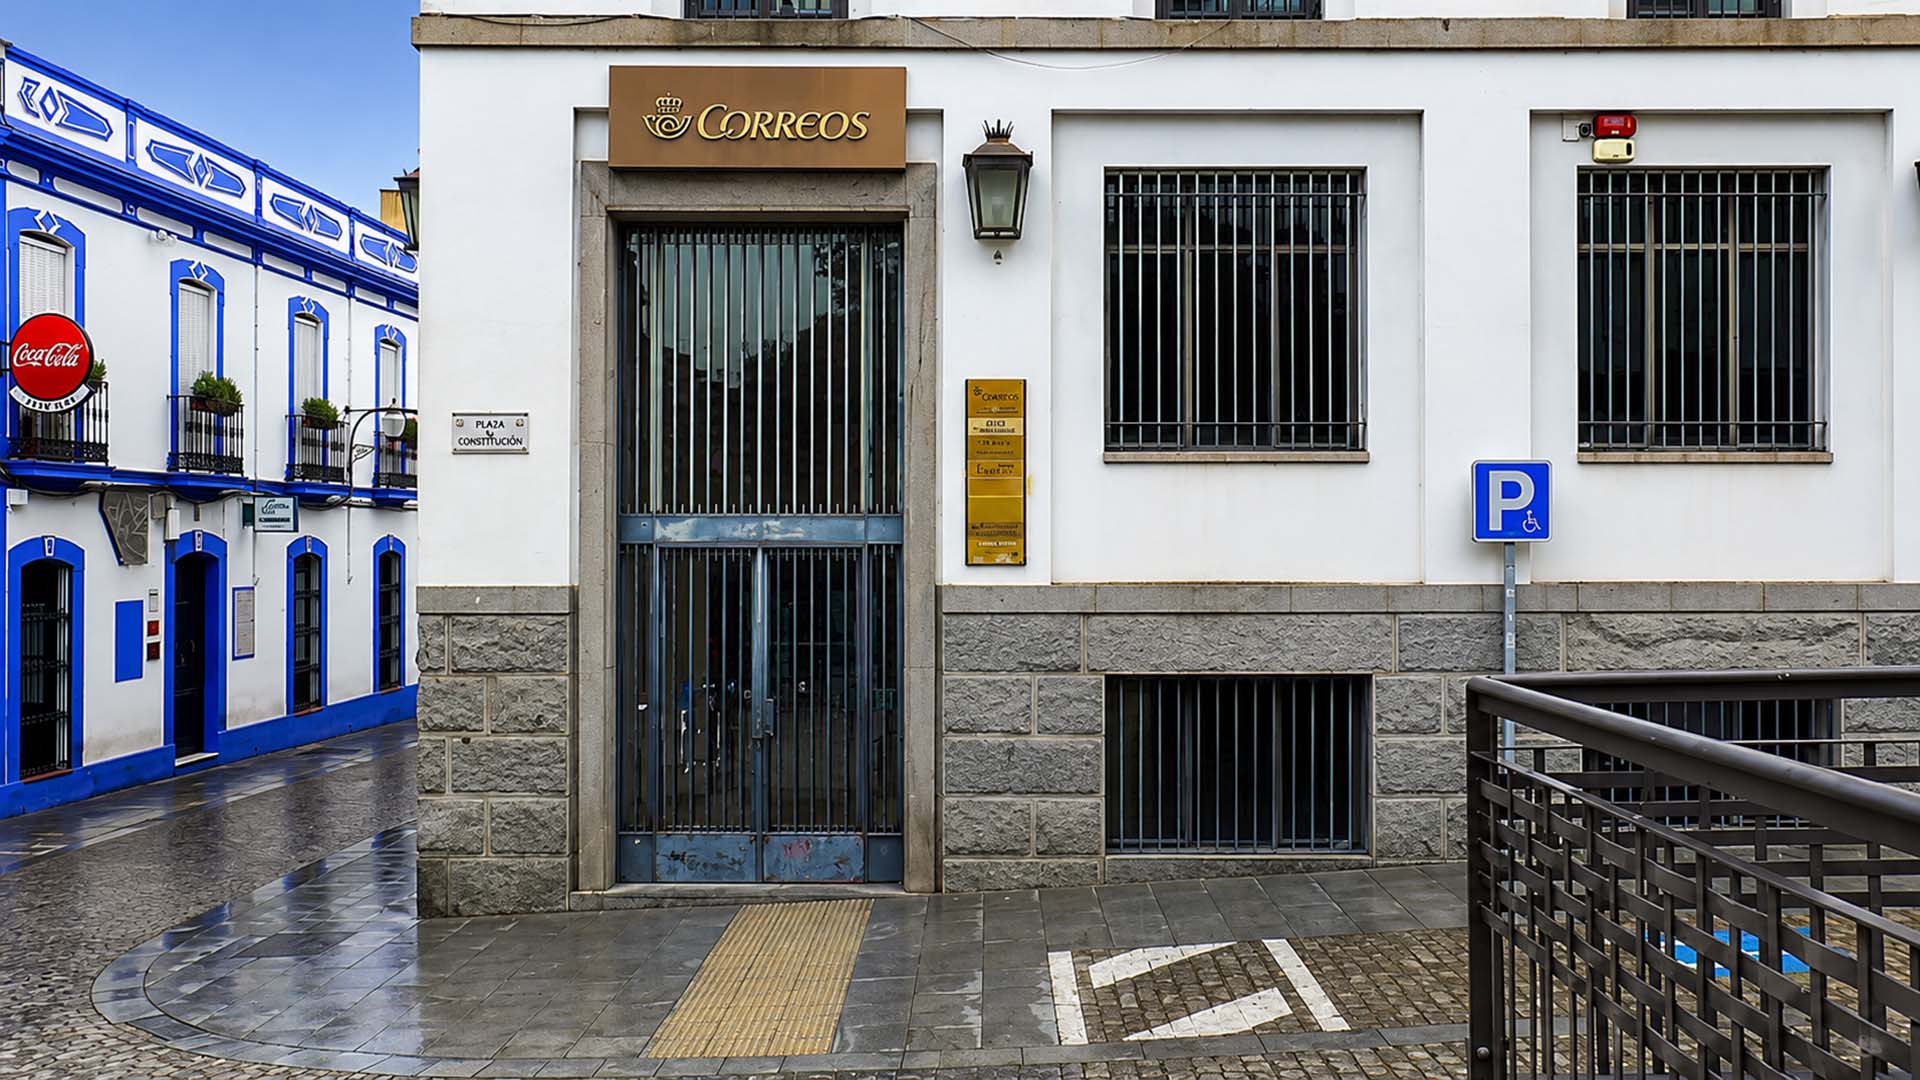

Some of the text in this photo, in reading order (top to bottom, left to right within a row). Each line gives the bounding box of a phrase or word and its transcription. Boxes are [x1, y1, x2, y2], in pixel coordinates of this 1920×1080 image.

[696, 103, 870, 141] CORREOS
[13, 342, 83, 367] Coca-Cola
[475, 420, 505, 429] PLAZA
[457, 434, 523, 446] CONSTITUCIÓN
[1488, 470, 1535, 531] P
